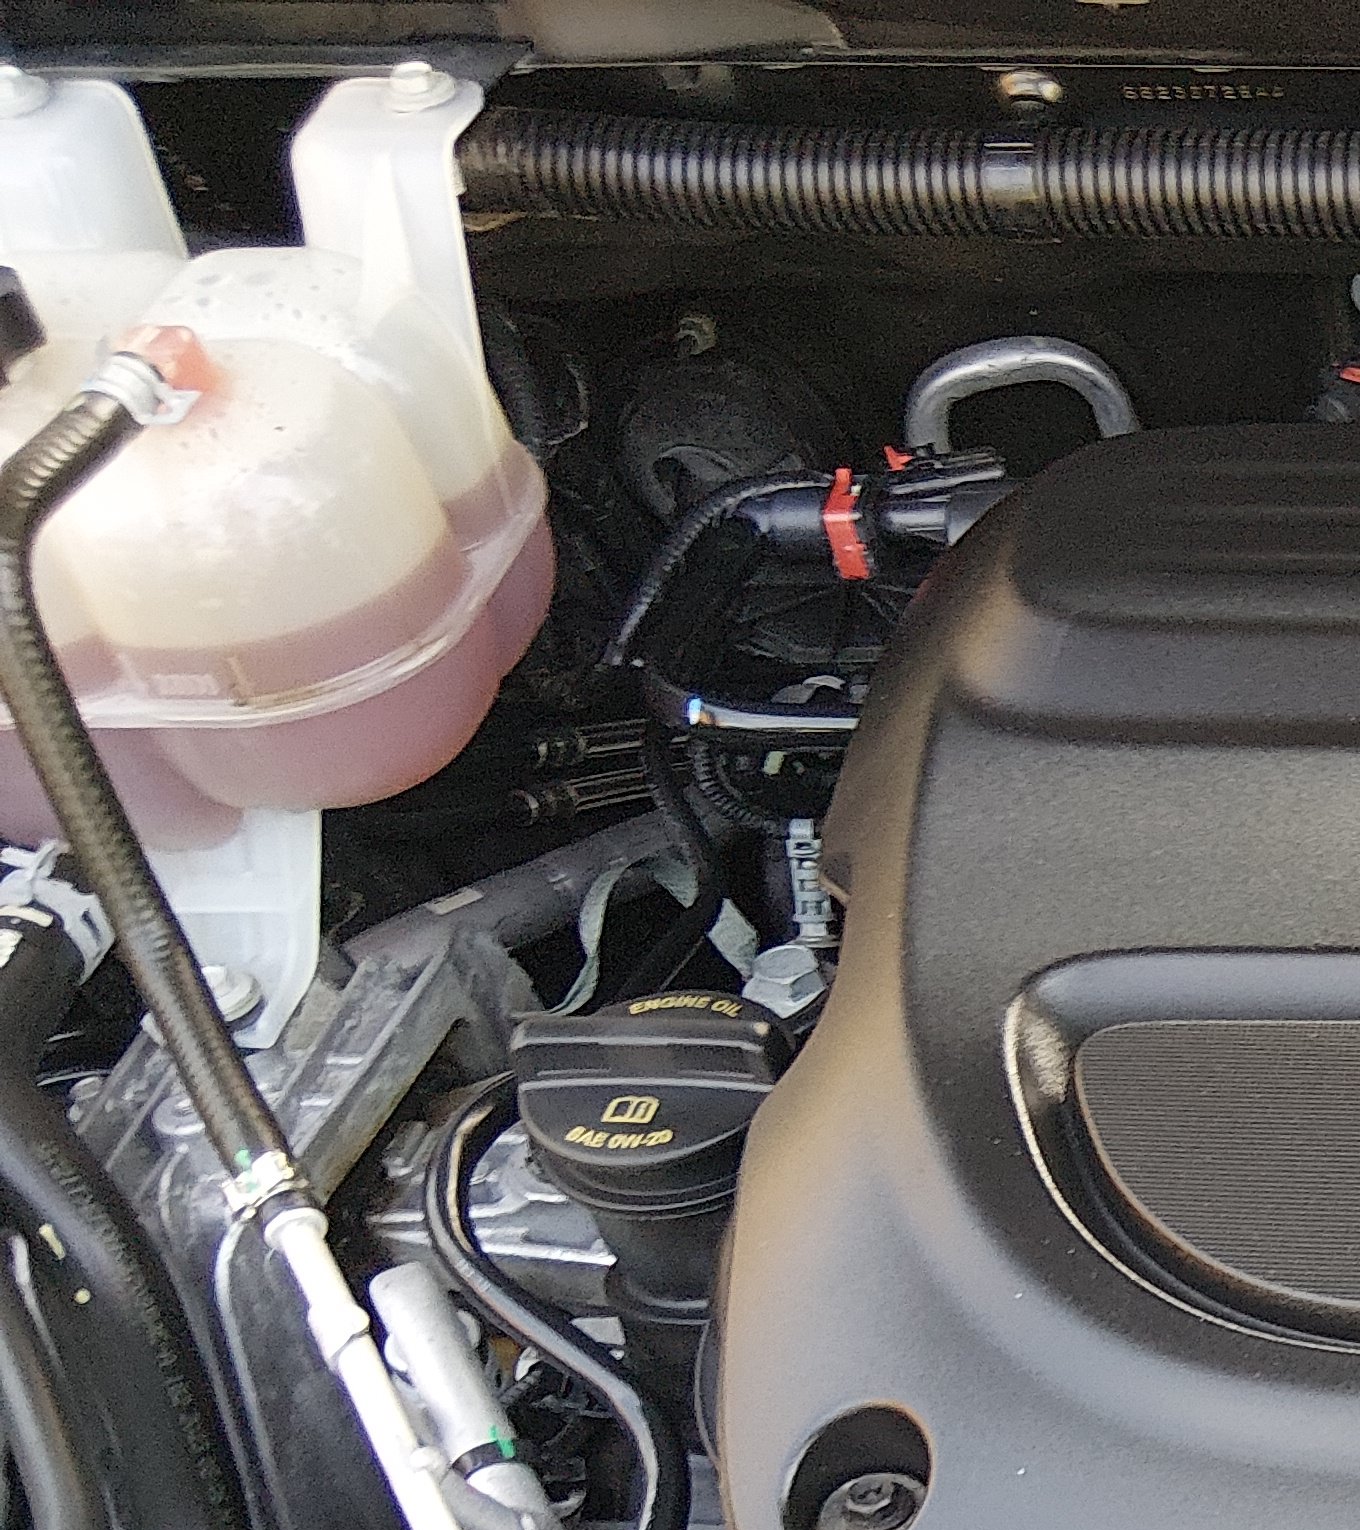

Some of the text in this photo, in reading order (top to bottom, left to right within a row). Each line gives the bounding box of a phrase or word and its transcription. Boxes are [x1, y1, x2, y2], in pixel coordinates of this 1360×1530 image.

[628, 994, 743, 1018] ENGINE OIL
[563, 1125, 605, 1148] SAE
